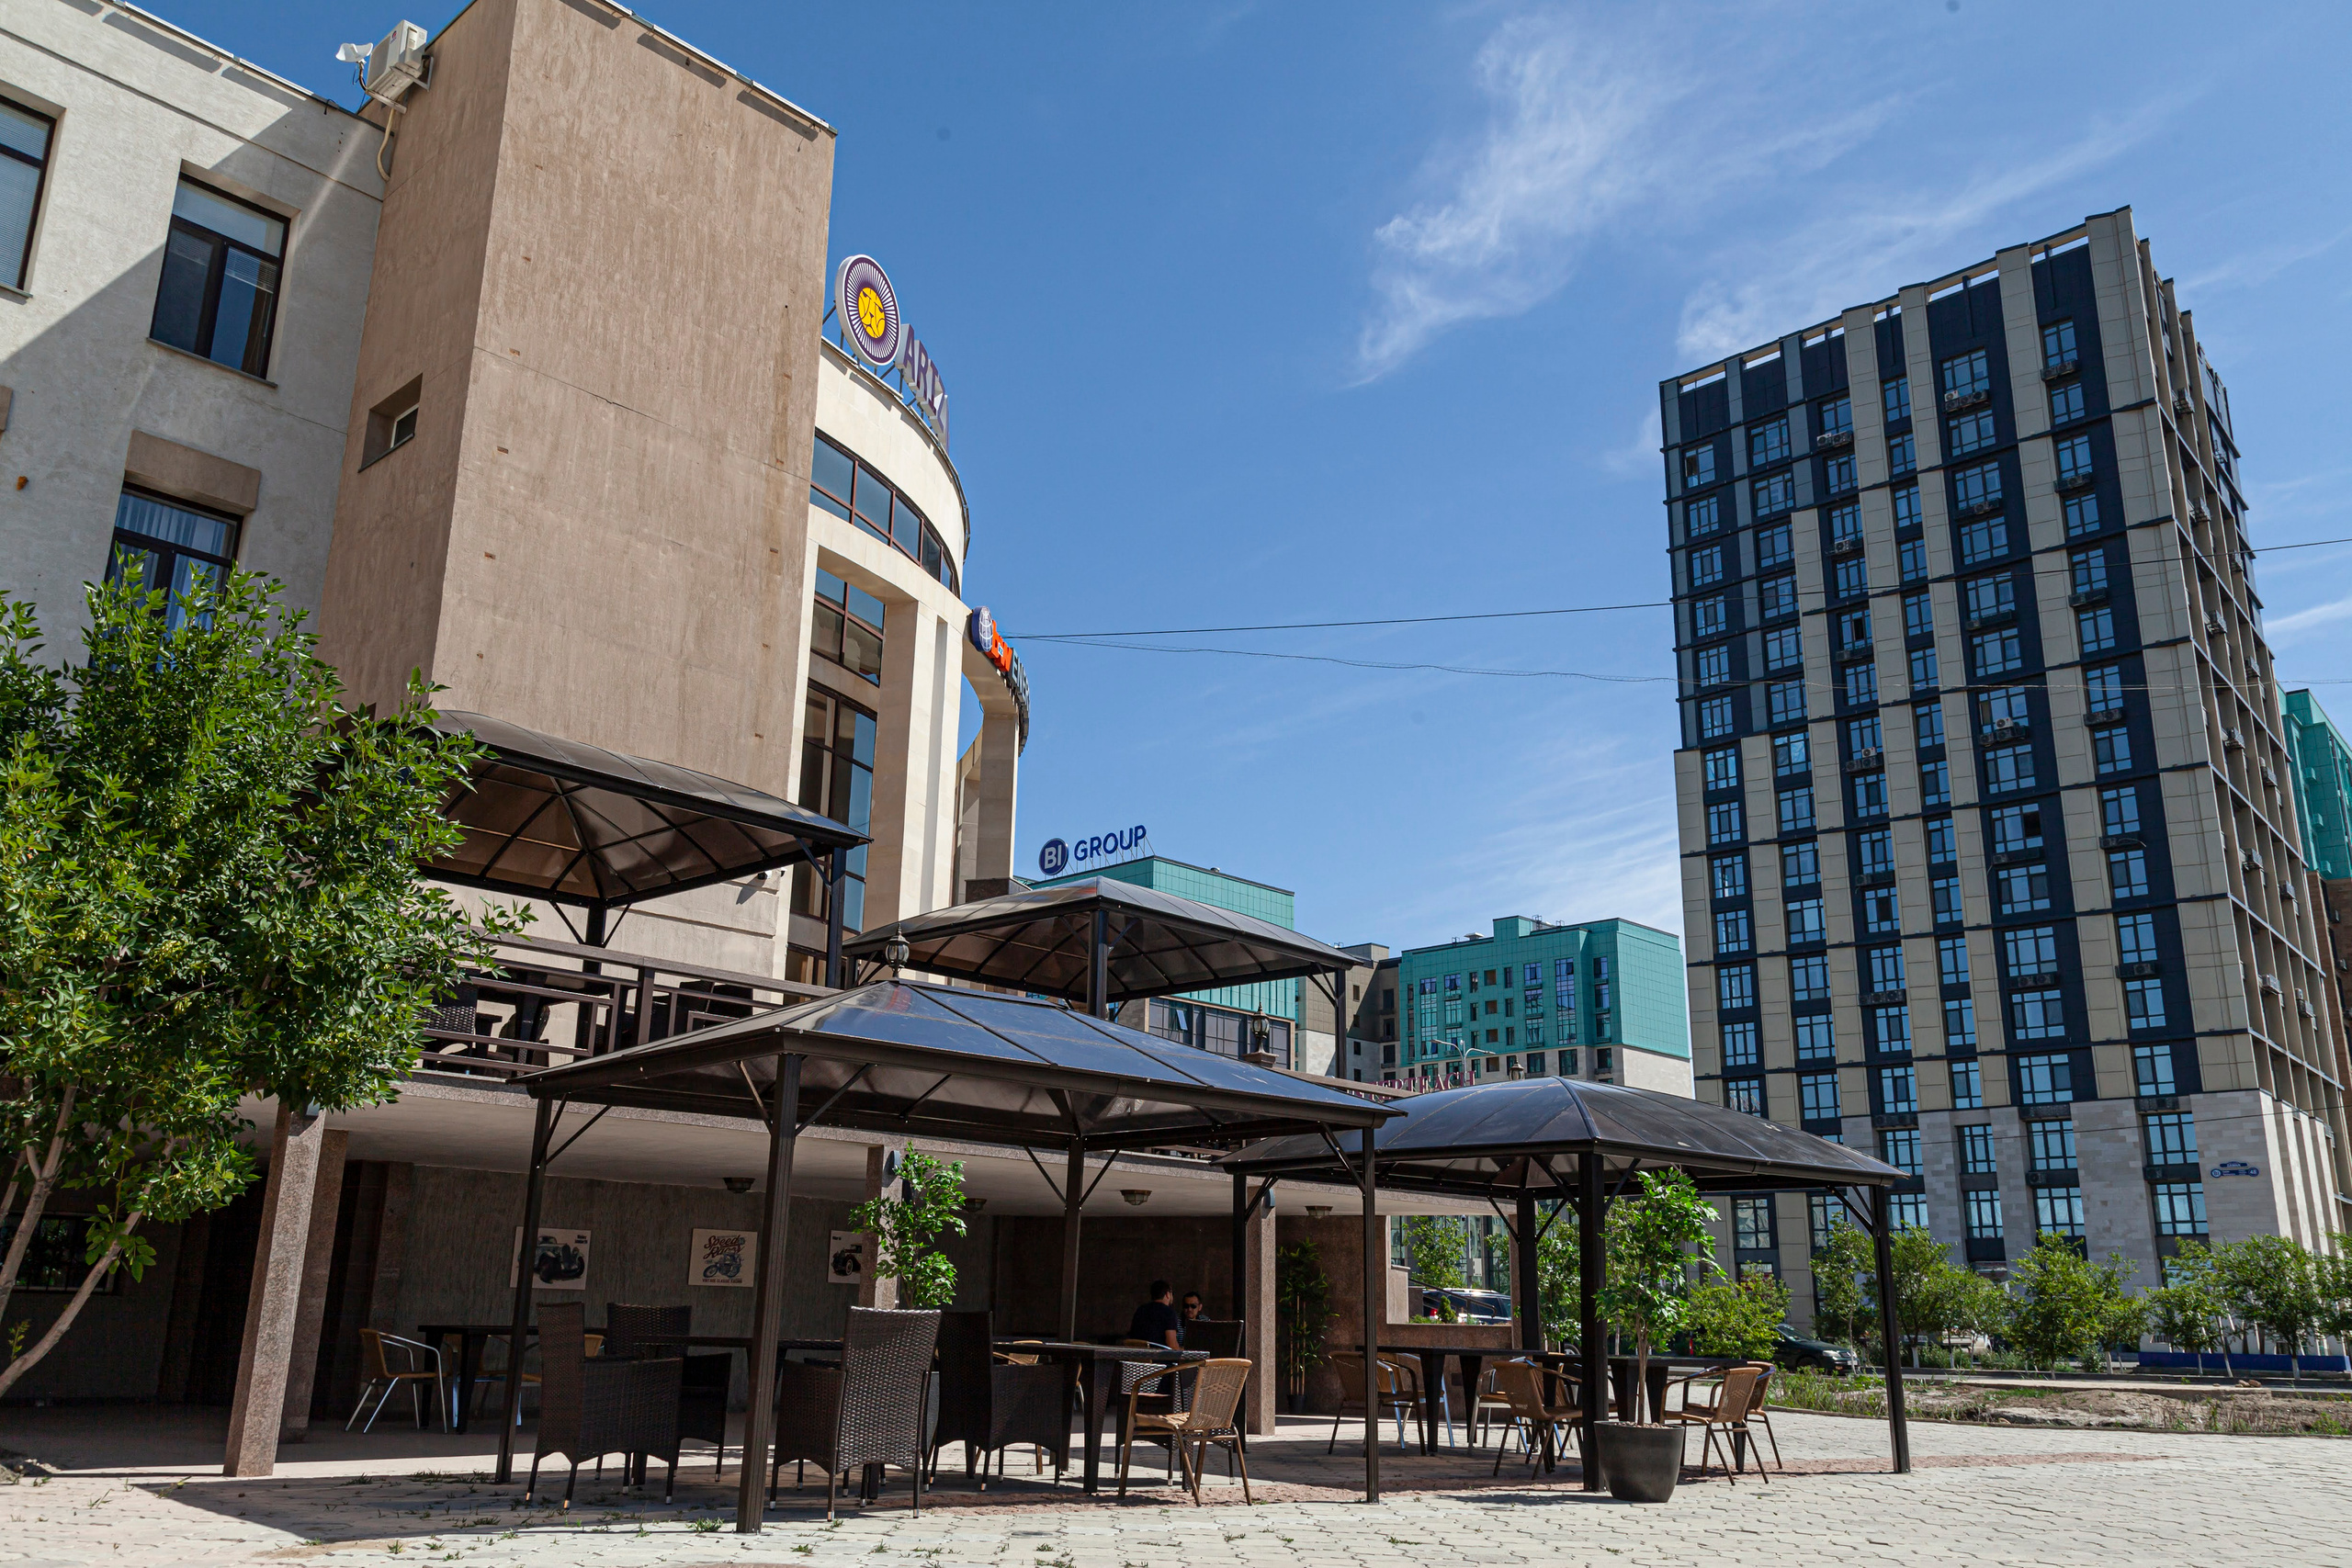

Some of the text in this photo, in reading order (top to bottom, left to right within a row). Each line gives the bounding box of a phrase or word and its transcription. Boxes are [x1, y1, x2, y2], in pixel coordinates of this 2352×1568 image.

[1044, 825, 1147, 870] BI GROUP
[704, 1235, 741, 1250] Speed
